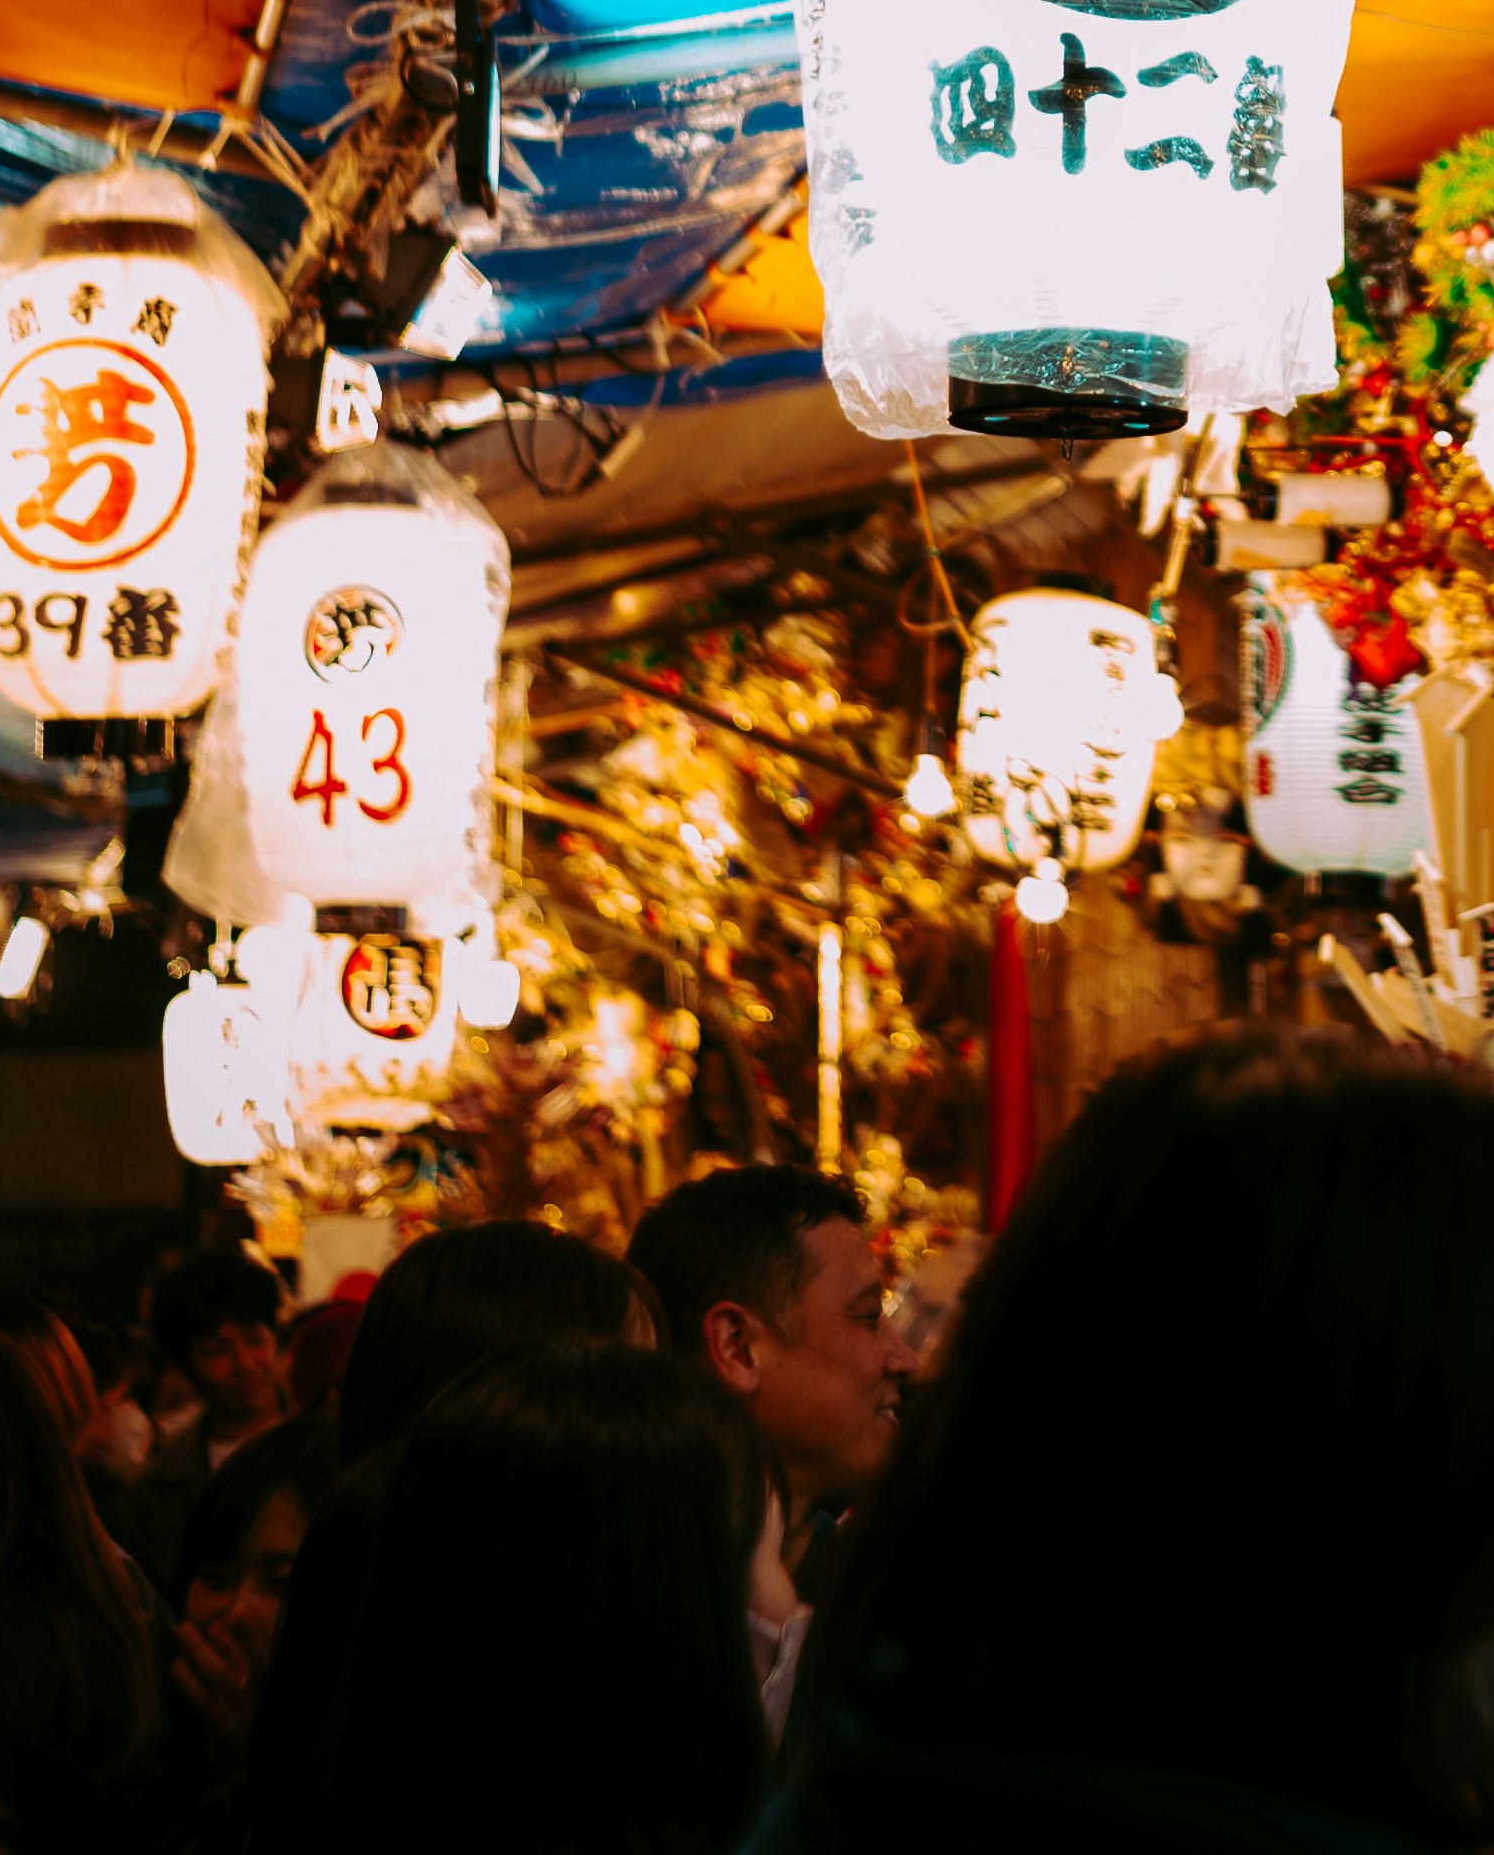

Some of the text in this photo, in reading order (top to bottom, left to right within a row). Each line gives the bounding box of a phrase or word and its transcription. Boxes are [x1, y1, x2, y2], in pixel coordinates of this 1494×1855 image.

[928, 31, 1289, 195] 四十二番
[291, 706, 412, 831] 43
